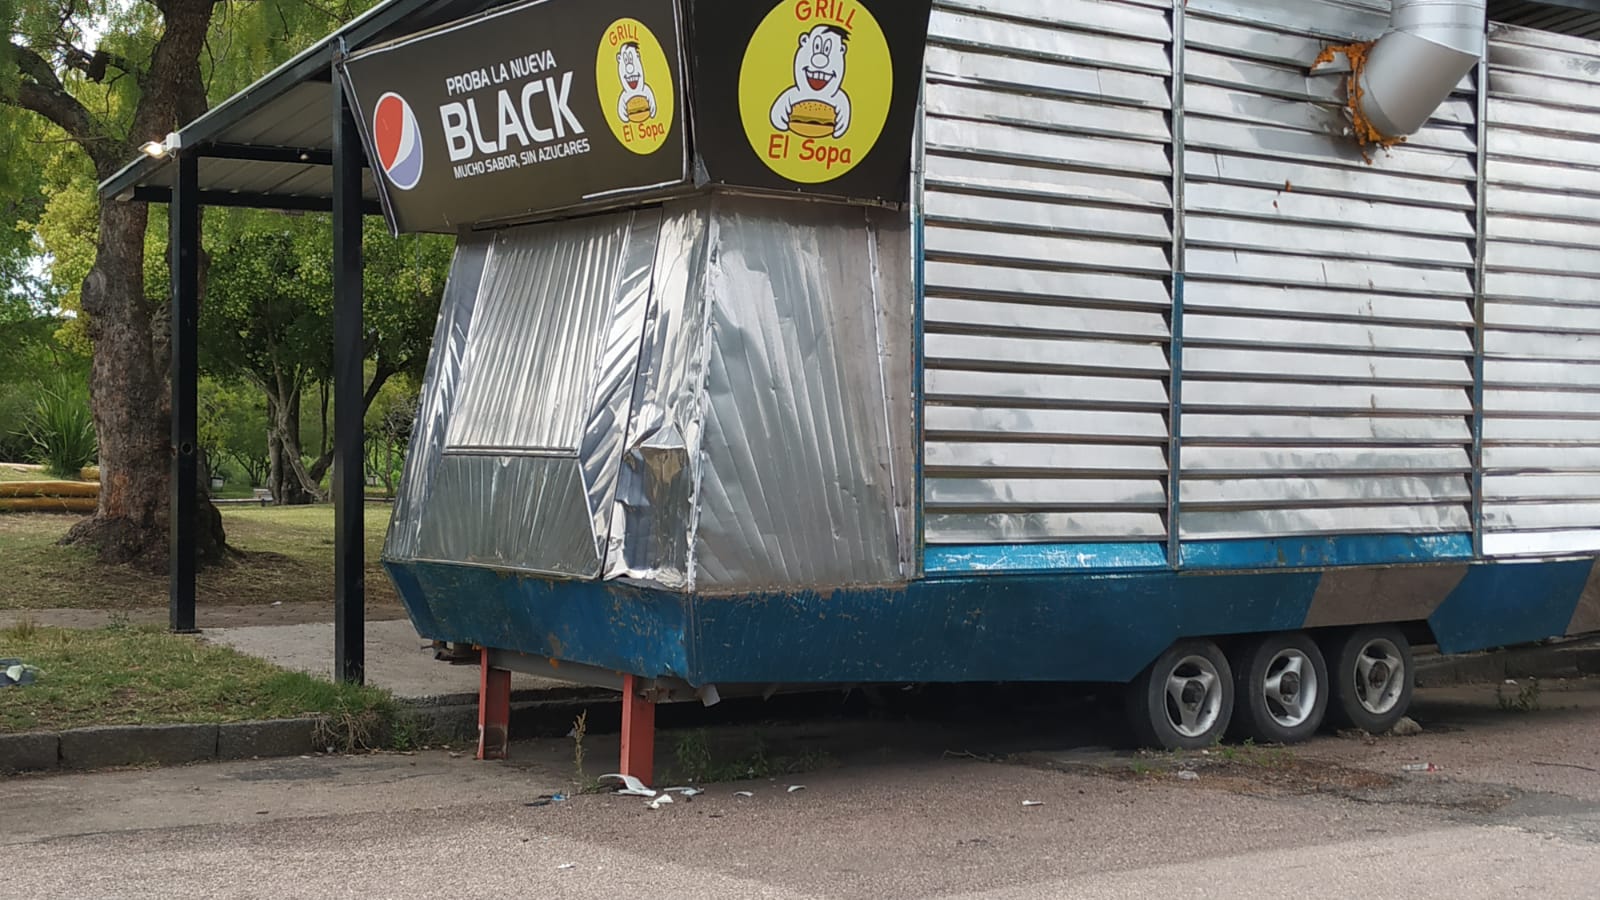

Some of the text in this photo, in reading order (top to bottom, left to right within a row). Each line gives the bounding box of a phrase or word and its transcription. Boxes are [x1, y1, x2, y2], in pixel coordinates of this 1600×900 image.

[795, 0, 856, 30] GRILL
[608, 24, 639, 47] GRILL
[446, 50, 557, 96] PROBA LA NUEVA
[439, 71, 585, 162] BLACK
[622, 123, 665, 146] El Sopa
[453, 138, 591, 179] MUCHO SABOR, SIN AZUCARES
[768, 134, 852, 170] El Sopa
